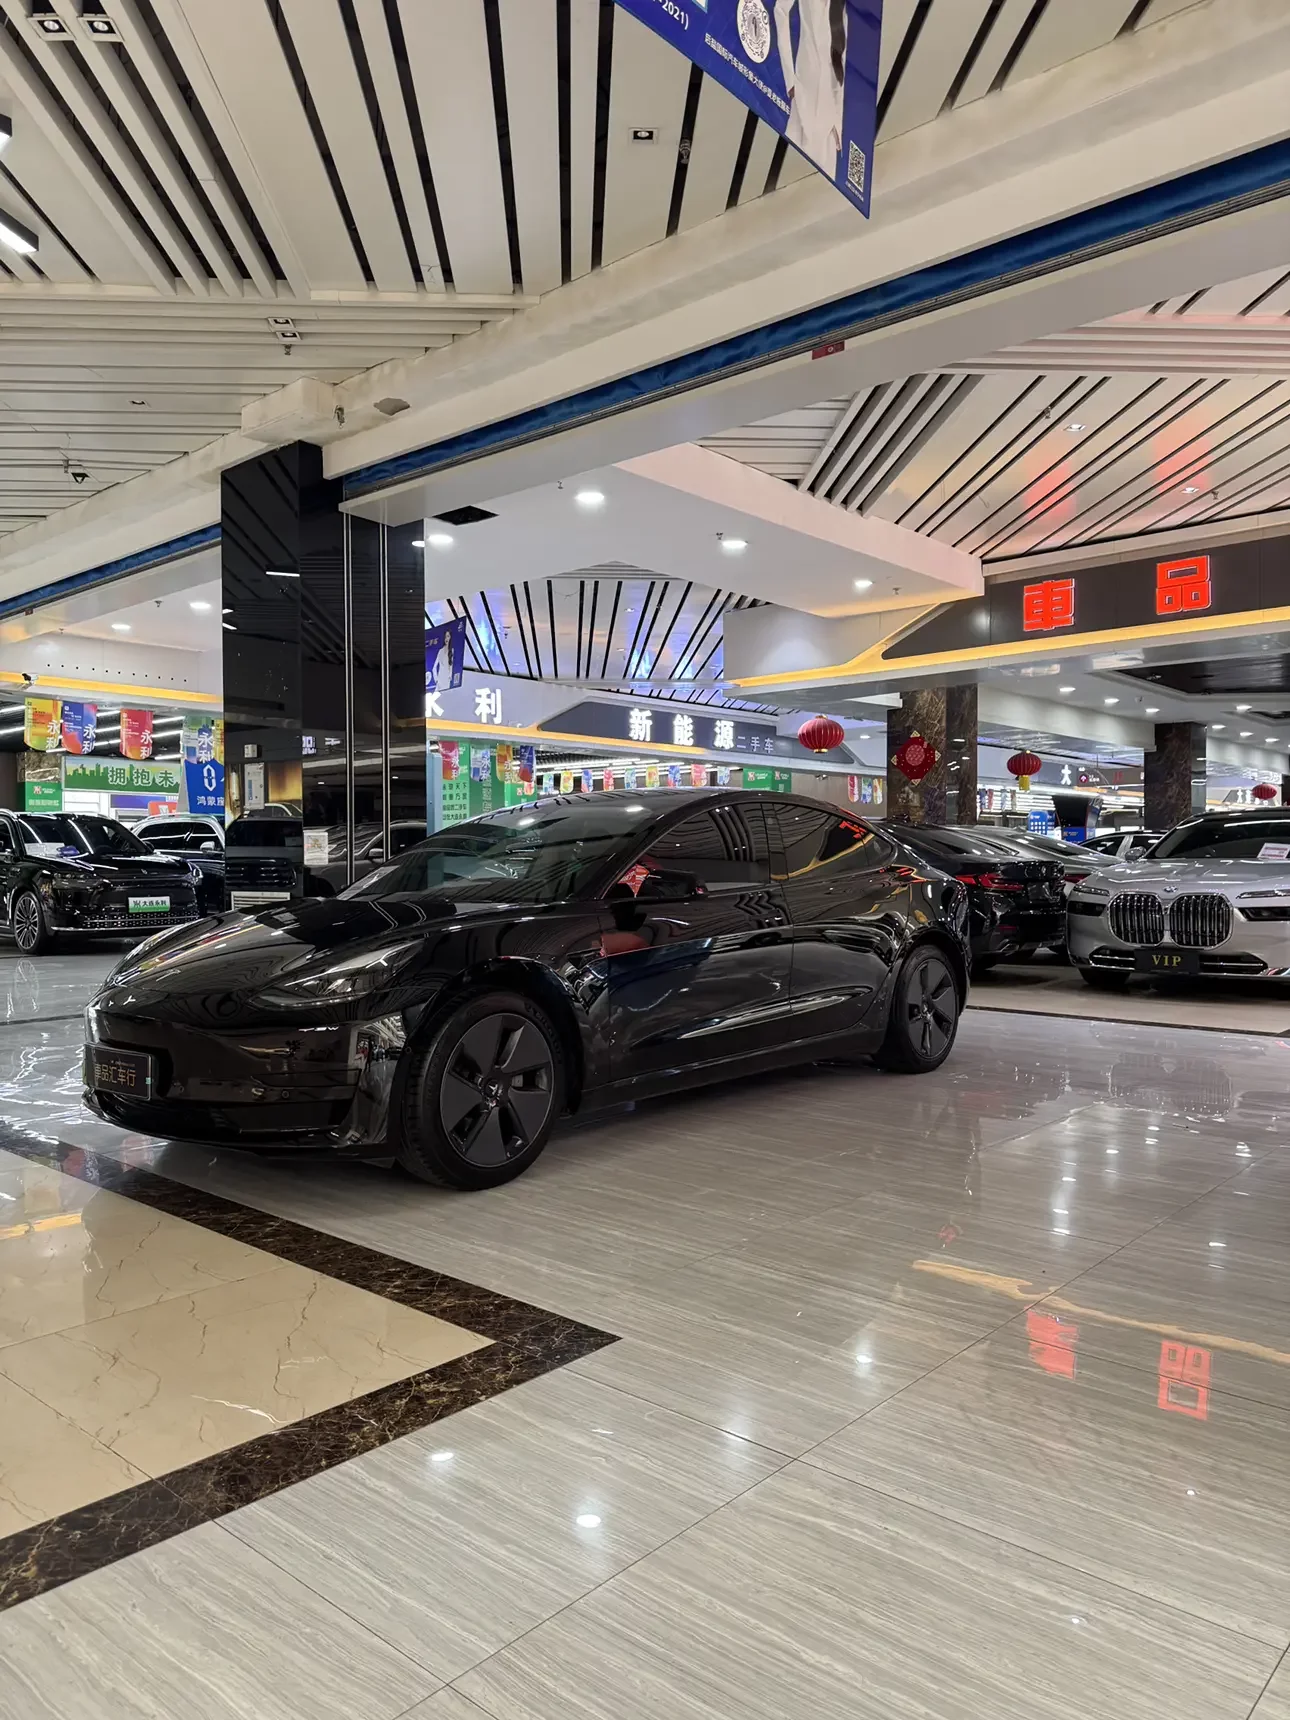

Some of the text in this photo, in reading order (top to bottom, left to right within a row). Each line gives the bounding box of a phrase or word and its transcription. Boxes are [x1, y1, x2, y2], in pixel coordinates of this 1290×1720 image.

[82, 723, 96, 754] 永利
[140, 729, 153, 759] 永利
[629, 708, 774, 753] 新能源 二手车
[108, 766, 175, 787] 拥抱未
[1152, 954, 1182, 967] VIP
